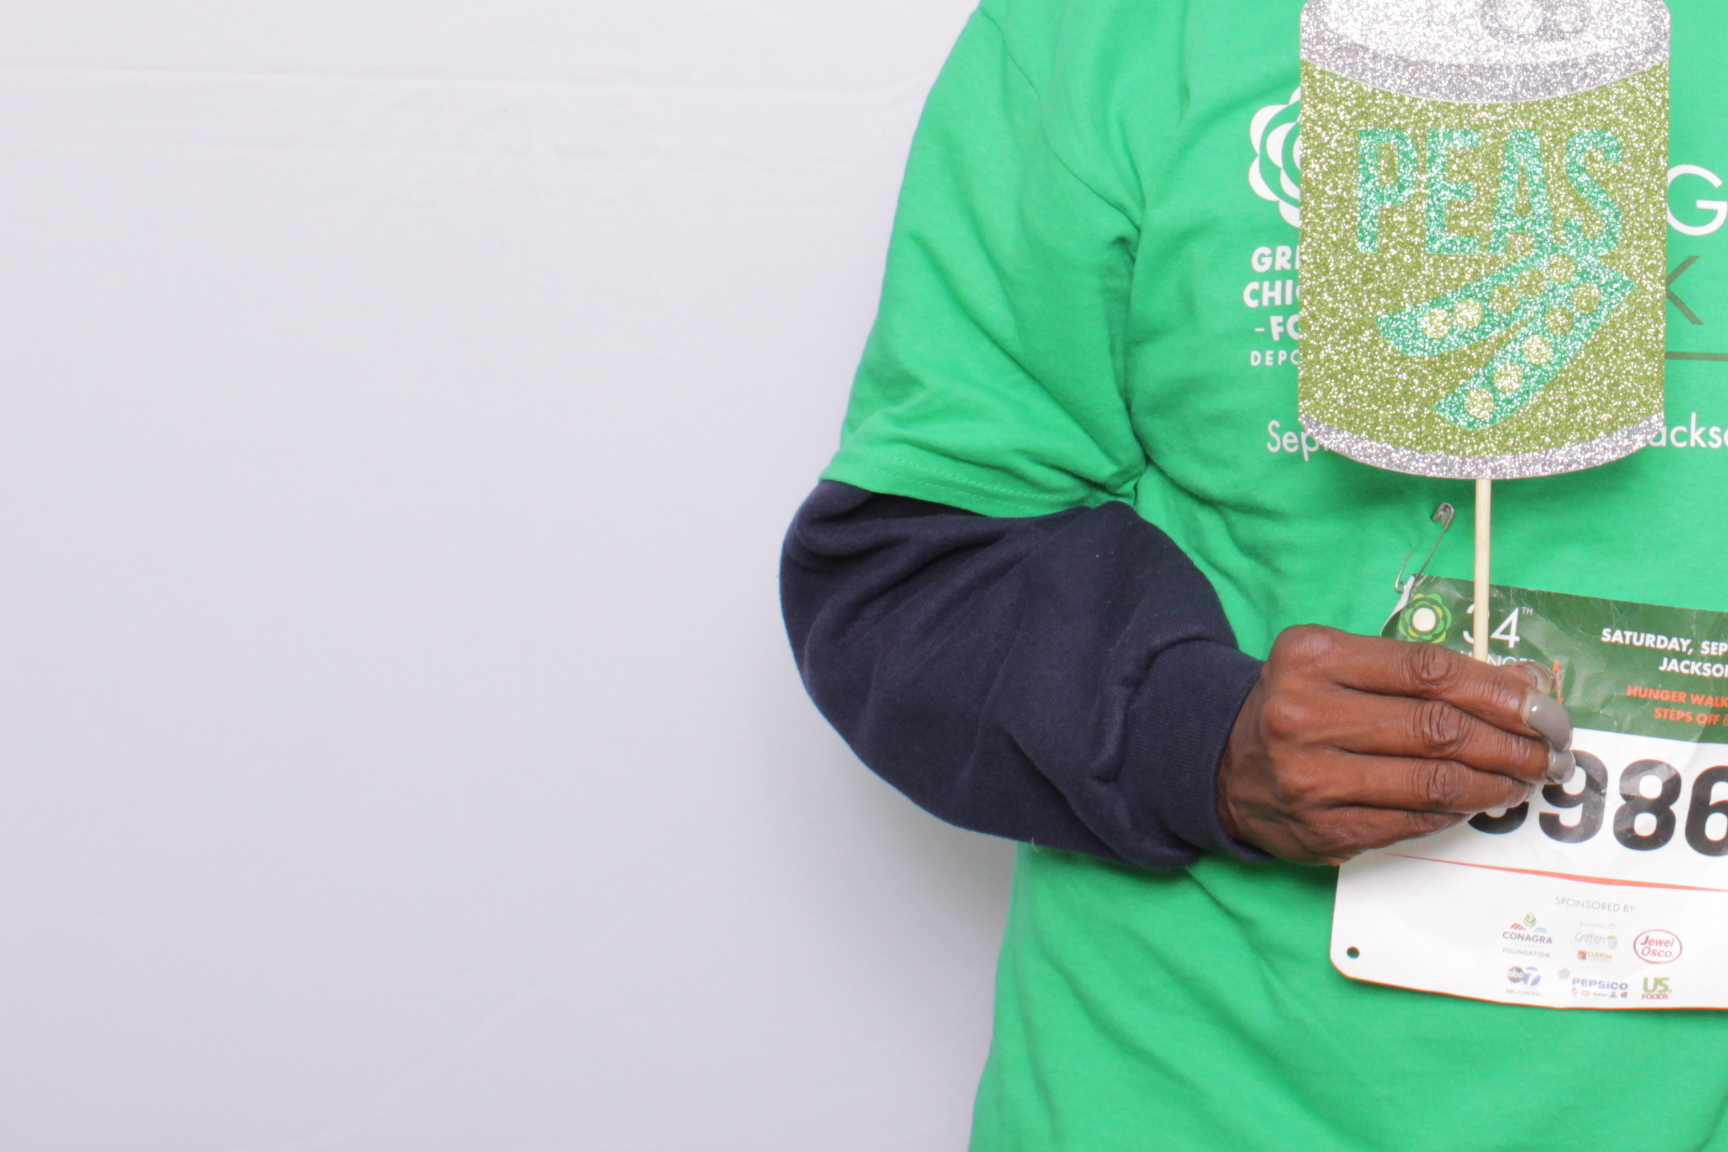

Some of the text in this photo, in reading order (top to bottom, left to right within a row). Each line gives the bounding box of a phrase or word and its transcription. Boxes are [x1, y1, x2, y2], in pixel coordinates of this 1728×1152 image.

[1357, 128, 1623, 255] PEAS
[1243, 279, 1300, 308] CHI
[1266, 420, 1330, 461] Sep
[1601, 627, 1694, 655] SATURDAY,
[1626, 685, 1687, 703] HUNGER
[1690, 693, 1728, 708] WALK
[1653, 707, 1692, 723] STEPS
[1696, 712, 1720, 725] OFF
[1555, 896, 1621, 912] SPONSORED
[1502, 931, 1553, 944] CONAGRA
[1640, 935, 1675, 947] Jewel
[1502, 947, 1551, 958] FOUNDATION
